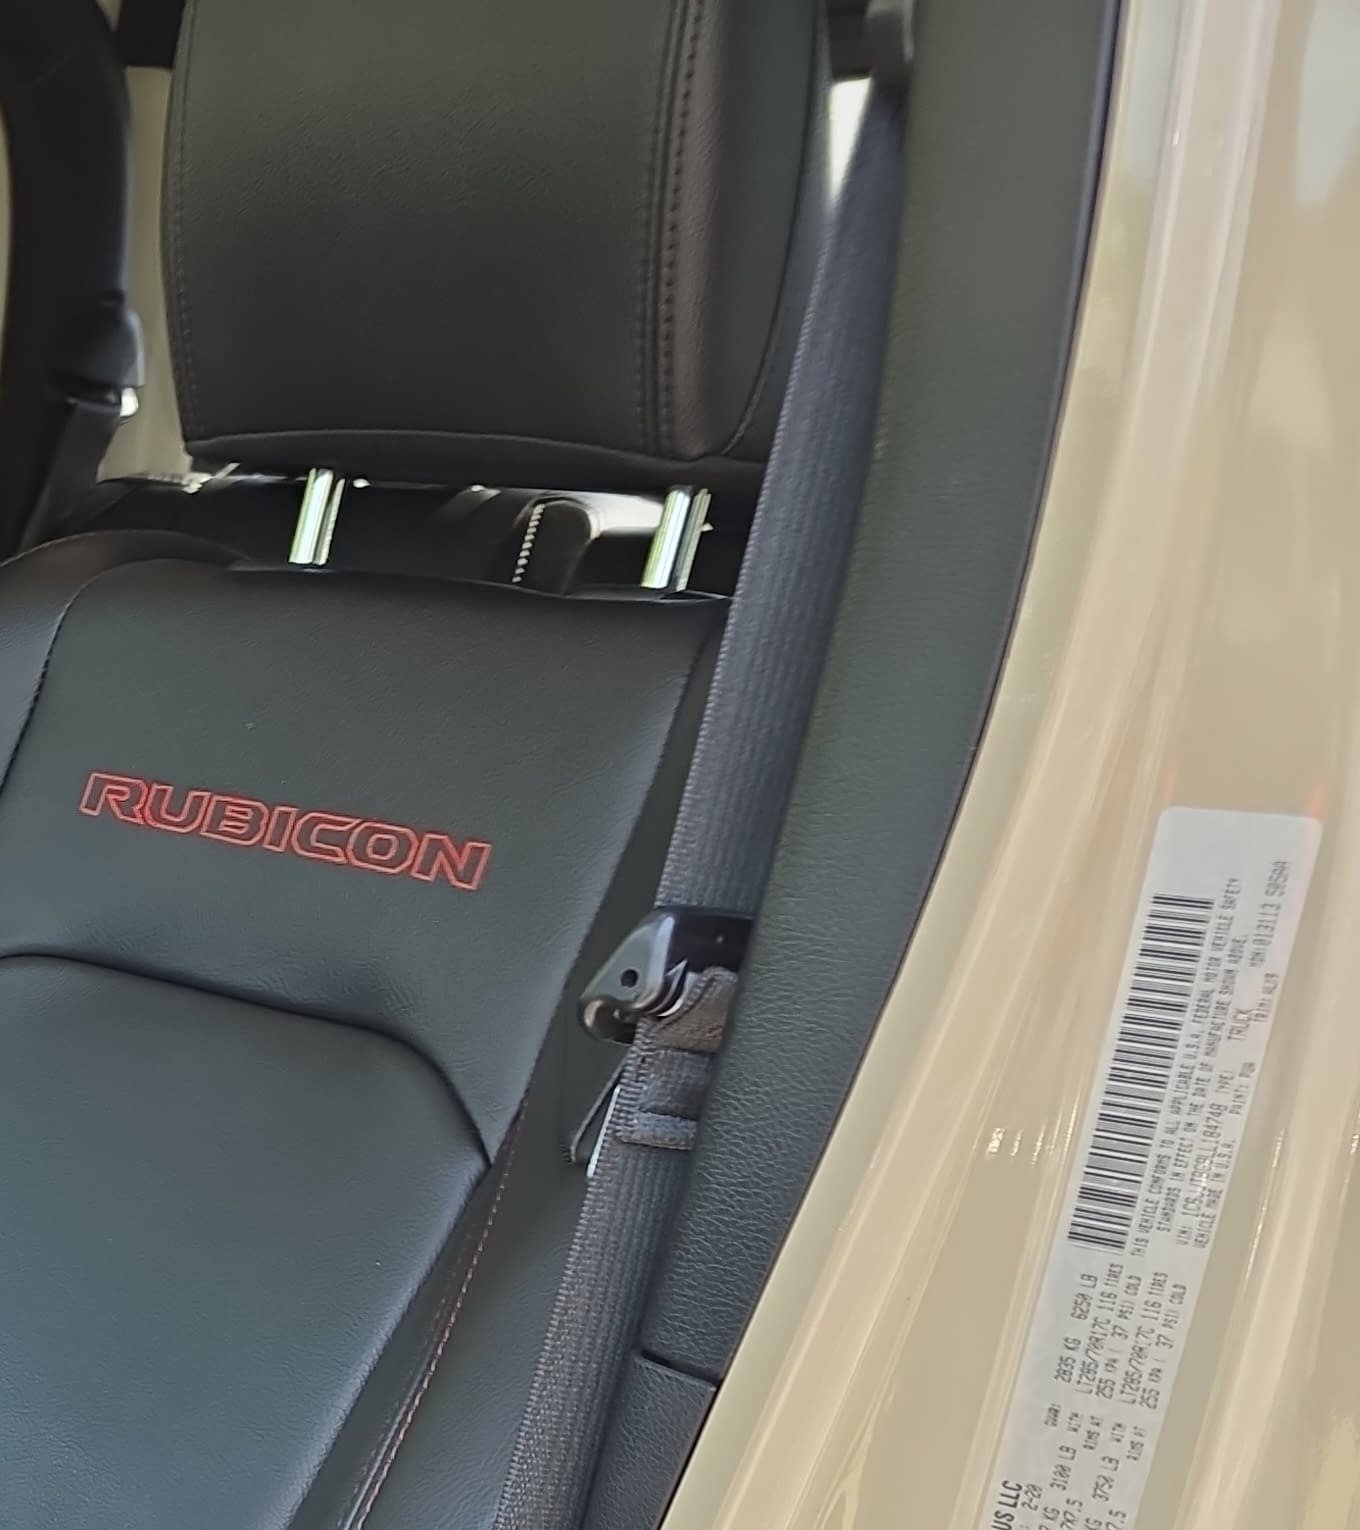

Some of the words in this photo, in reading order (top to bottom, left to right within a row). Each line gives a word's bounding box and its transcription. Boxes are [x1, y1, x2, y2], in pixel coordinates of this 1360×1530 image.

[80, 771, 492, 890] RUBICON
[1219, 877, 1244, 911] SAFETY
[1209, 914, 1234, 952] VEHICLE
[1201, 955, 1223, 983] MOTOR
[1217, 967, 1240, 995] SHOWN
[1190, 987, 1215, 1024] FEDERAL
[1201, 998, 1232, 1057] MANUFACTURE
[1225, 1006, 1254, 1042] TRUCK
[1197, 1061, 1215, 1073] OF
[1167, 1063, 1195, 1116] APPLICABLE
[1191, 1076, 1211, 1098] DATE
[1186, 1101, 1204, 1117] THE
[1161, 1118, 1180, 1135] ALL
[1181, 1121, 1199, 1133] ON
[1158, 1138, 1175, 1149] TO
[1172, 1136, 1195, 1169] EFFECT
[1146, 1153, 1172, 1195] CONFORMS
[1169, 1170, 1186, 1182] IN
[1209, 1170, 1227, 1183] IN
[1155, 1185, 1182, 1233] STANDARDS
[1202, 1187, 1223, 1210] MADE
[1136, 1197, 1160, 1234] VEHICLE
[1192, 1211, 1216, 1249] VEHICLE
[1129, 1236, 1149, 1258] THIS
[1077, 1272, 1098, 1289] LB
[1069, 1291, 1093, 1321] 6250
[1095, 1289, 1117, 1311] 116
[1138, 1298, 1162, 1321] 116
[1061, 1336, 1082, 1352] KG
[1053, 1354, 1077, 1383] 2835
[1094, 1376, 1116, 1399] 255
[1110, 1323, 1130, 1340] 37
[1138, 1386, 1161, 1410] 255
[1154, 1332, 1176, 1349] 37
[1056, 1444, 1077, 1461] LB
[1098, 1454, 1120, 1472] LB
[1048, 1462, 1071, 1491] 3100
[1090, 1473, 1115, 1503] 3750
[996, 1478, 1023, 1509] LLC
[1020, 1482, 1043, 1511] 2-20
[1040, 1504, 1060, 1522] KG
